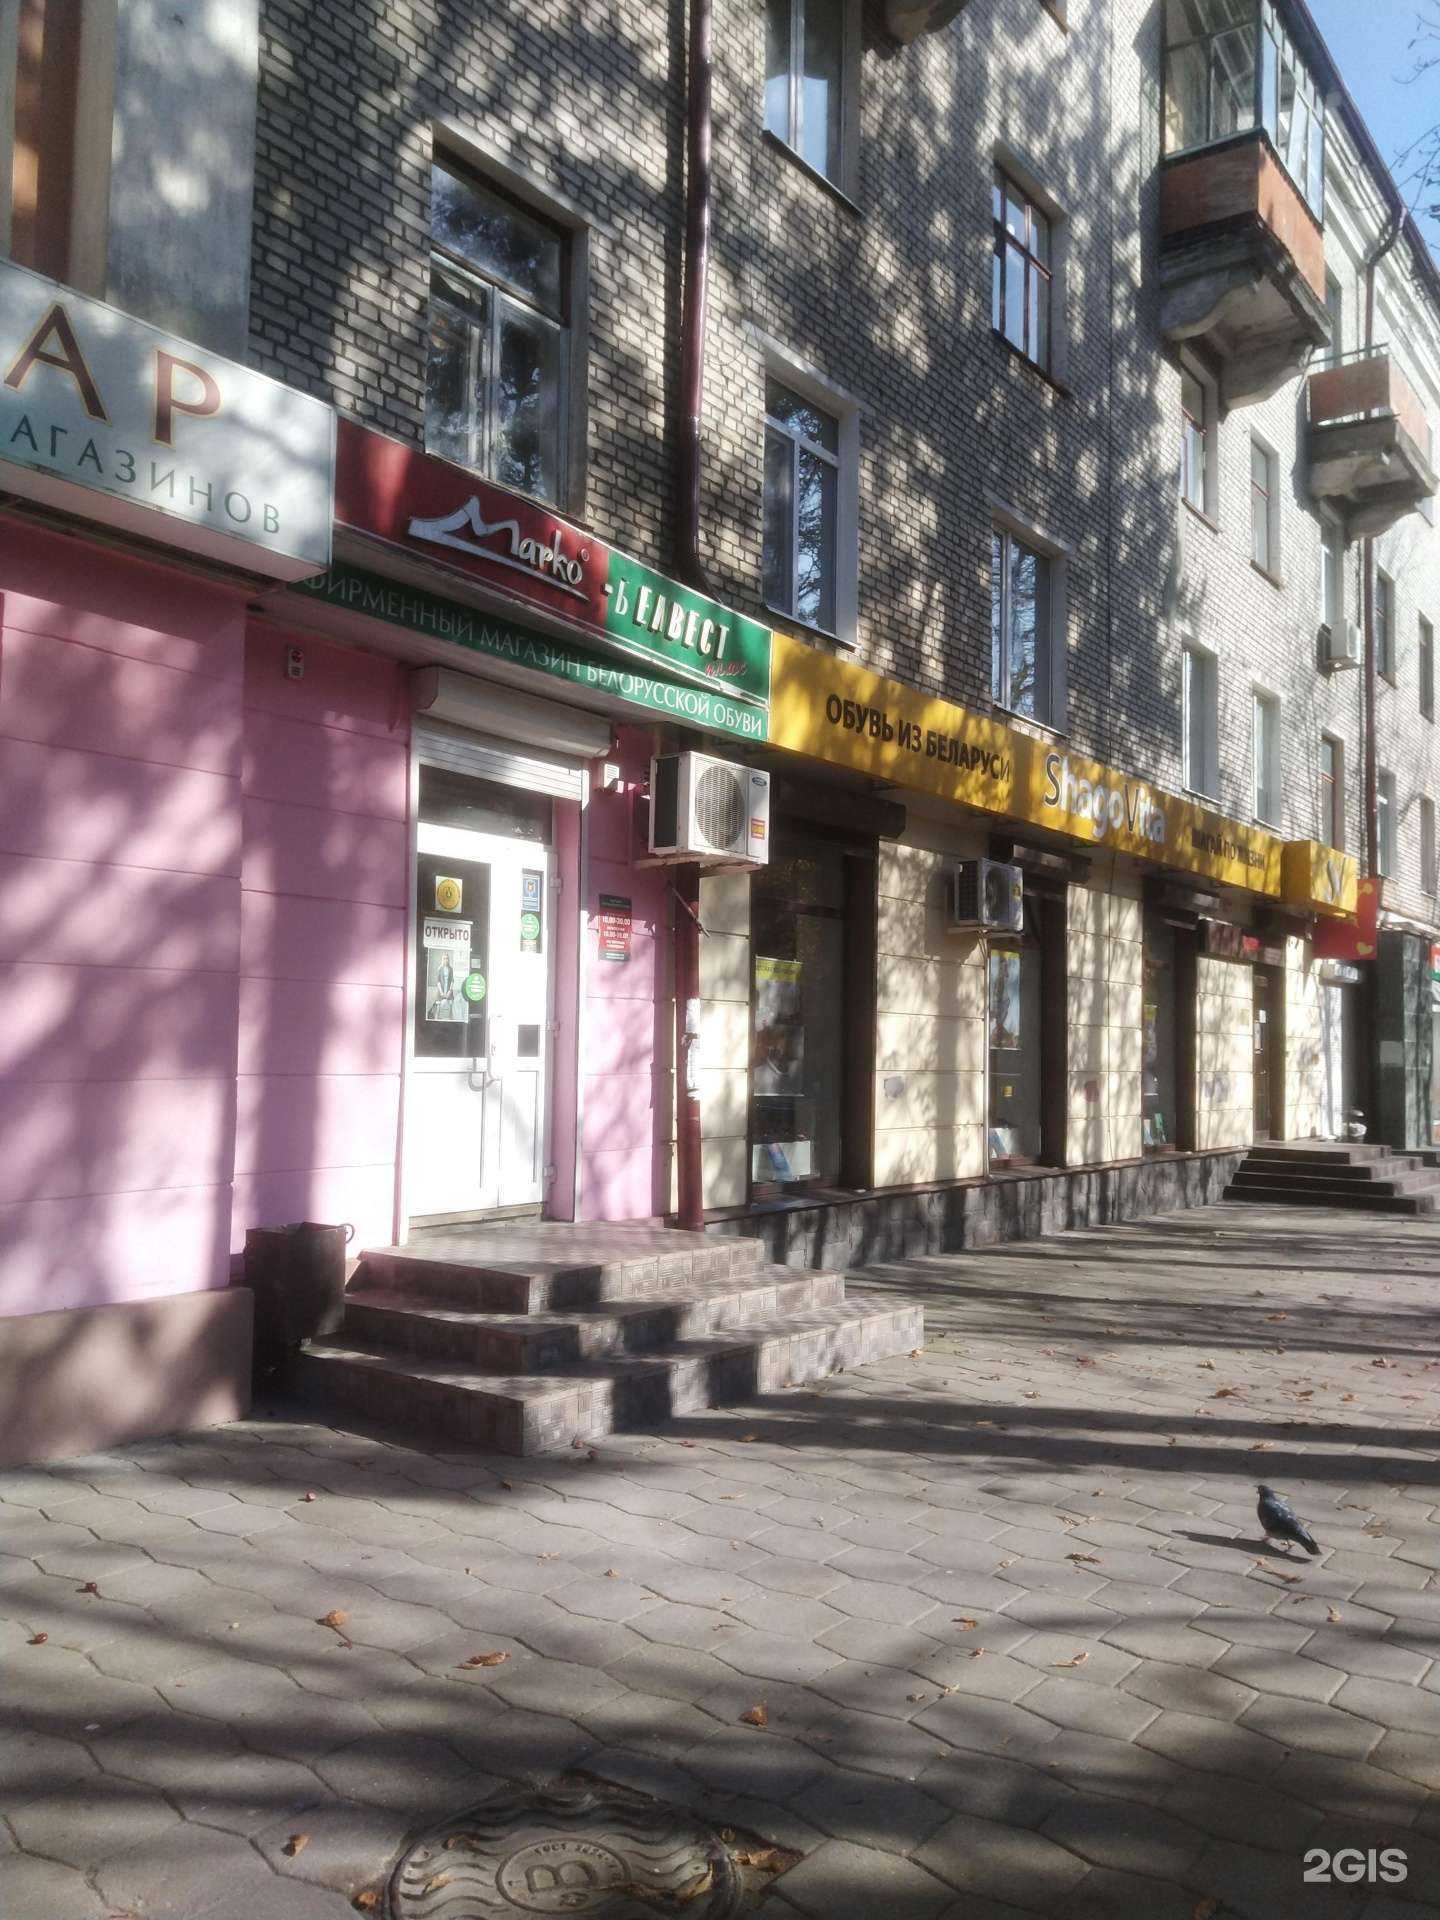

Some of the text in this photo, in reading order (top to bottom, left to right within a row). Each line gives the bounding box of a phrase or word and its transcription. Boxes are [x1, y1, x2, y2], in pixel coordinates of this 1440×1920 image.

[479, 623, 581, 678] МАГАЗИН
[586, 662, 710, 719] БЕЛОРУССКОЙ
[713, 702, 763, 737] ОБУВИ
[826, 694, 1011, 783] ОБУВЬ ИЗ БЕЛАРУСИ
[1043, 752, 1165, 844] ShagoVita
[425, 926, 470, 941] ОТКРЫТО
